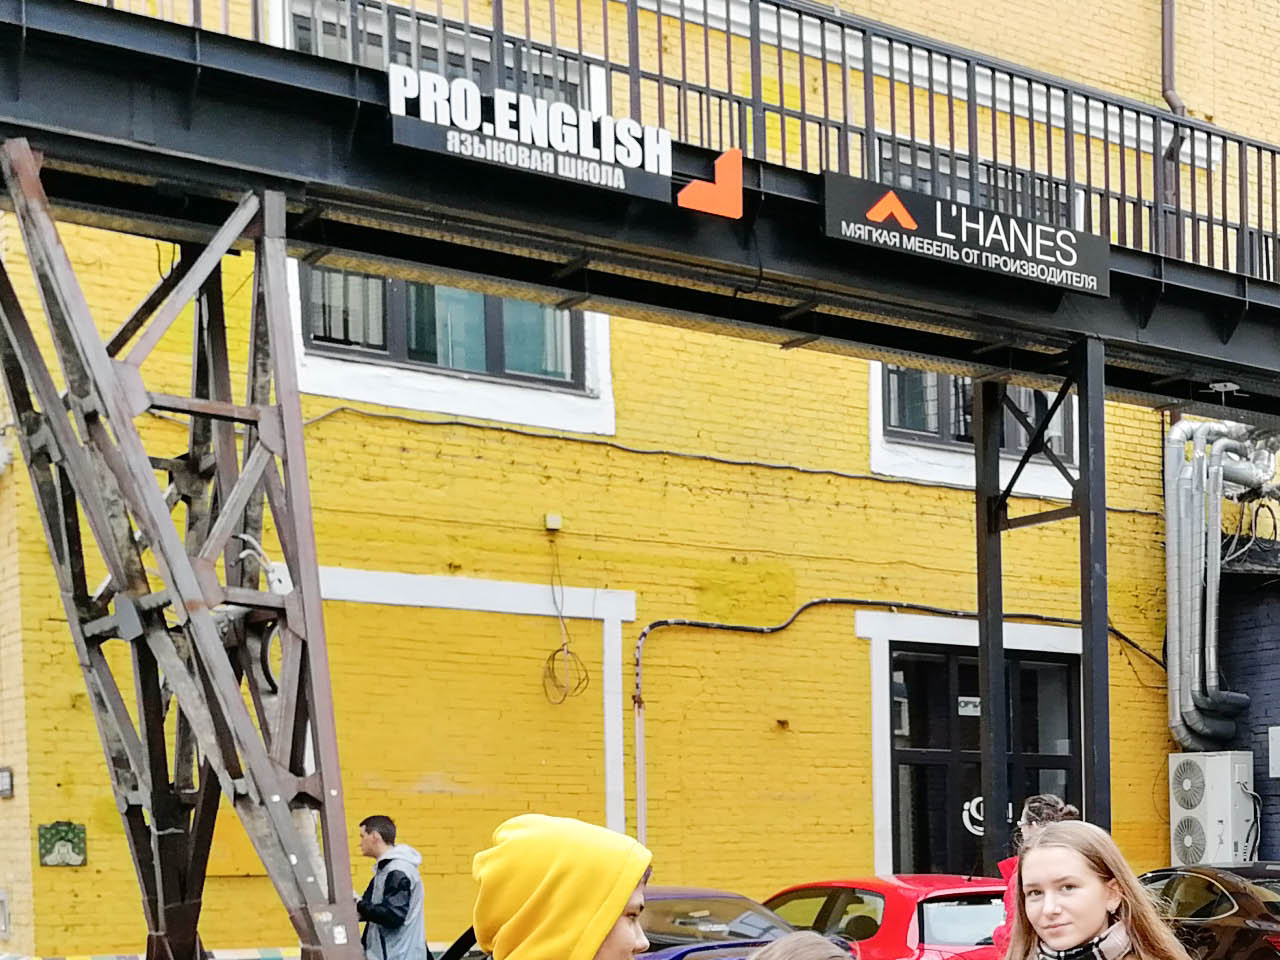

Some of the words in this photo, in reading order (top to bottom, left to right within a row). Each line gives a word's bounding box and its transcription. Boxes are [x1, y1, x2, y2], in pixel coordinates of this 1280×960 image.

[389, 62, 673, 177] PRO.ENGLISH
[446, 130, 555, 174] ЯЗЫКОВАЯ
[557, 154, 626, 190] ШКОЛА
[841, 220, 900, 248] МЯГКАЯ
[902, 235, 960, 261] МЕБЕЛЬ
[961, 247, 981, 266] ОТ
[982, 252, 1098, 291] ПРОИЗВОДИТЕЛЯ
[936, 200, 1078, 267] L'HANES
